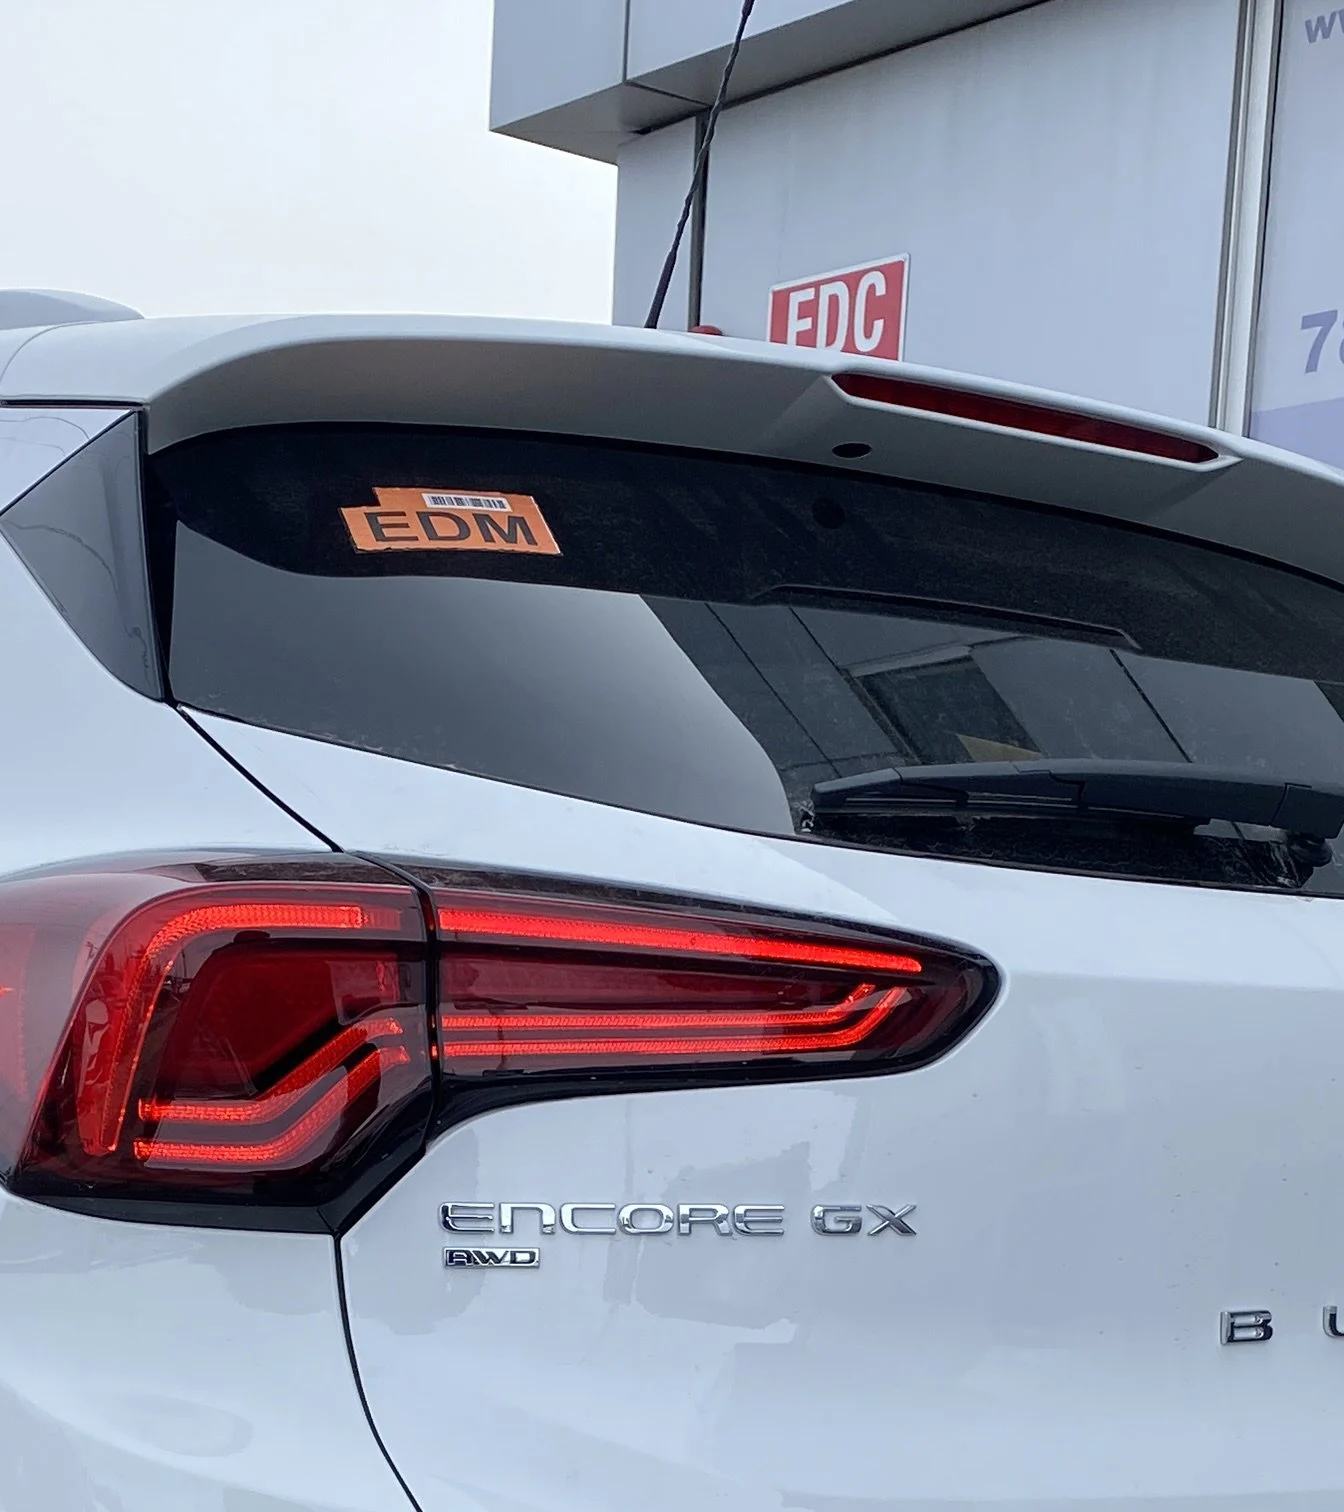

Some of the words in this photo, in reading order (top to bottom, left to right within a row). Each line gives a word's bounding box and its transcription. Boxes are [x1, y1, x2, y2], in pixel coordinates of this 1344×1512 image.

[364, 511, 538, 546] EDM
[438, 1202, 784, 1236] ENCORE
[810, 1204, 917, 1236] GX
[445, 1248, 539, 1267] AWD
